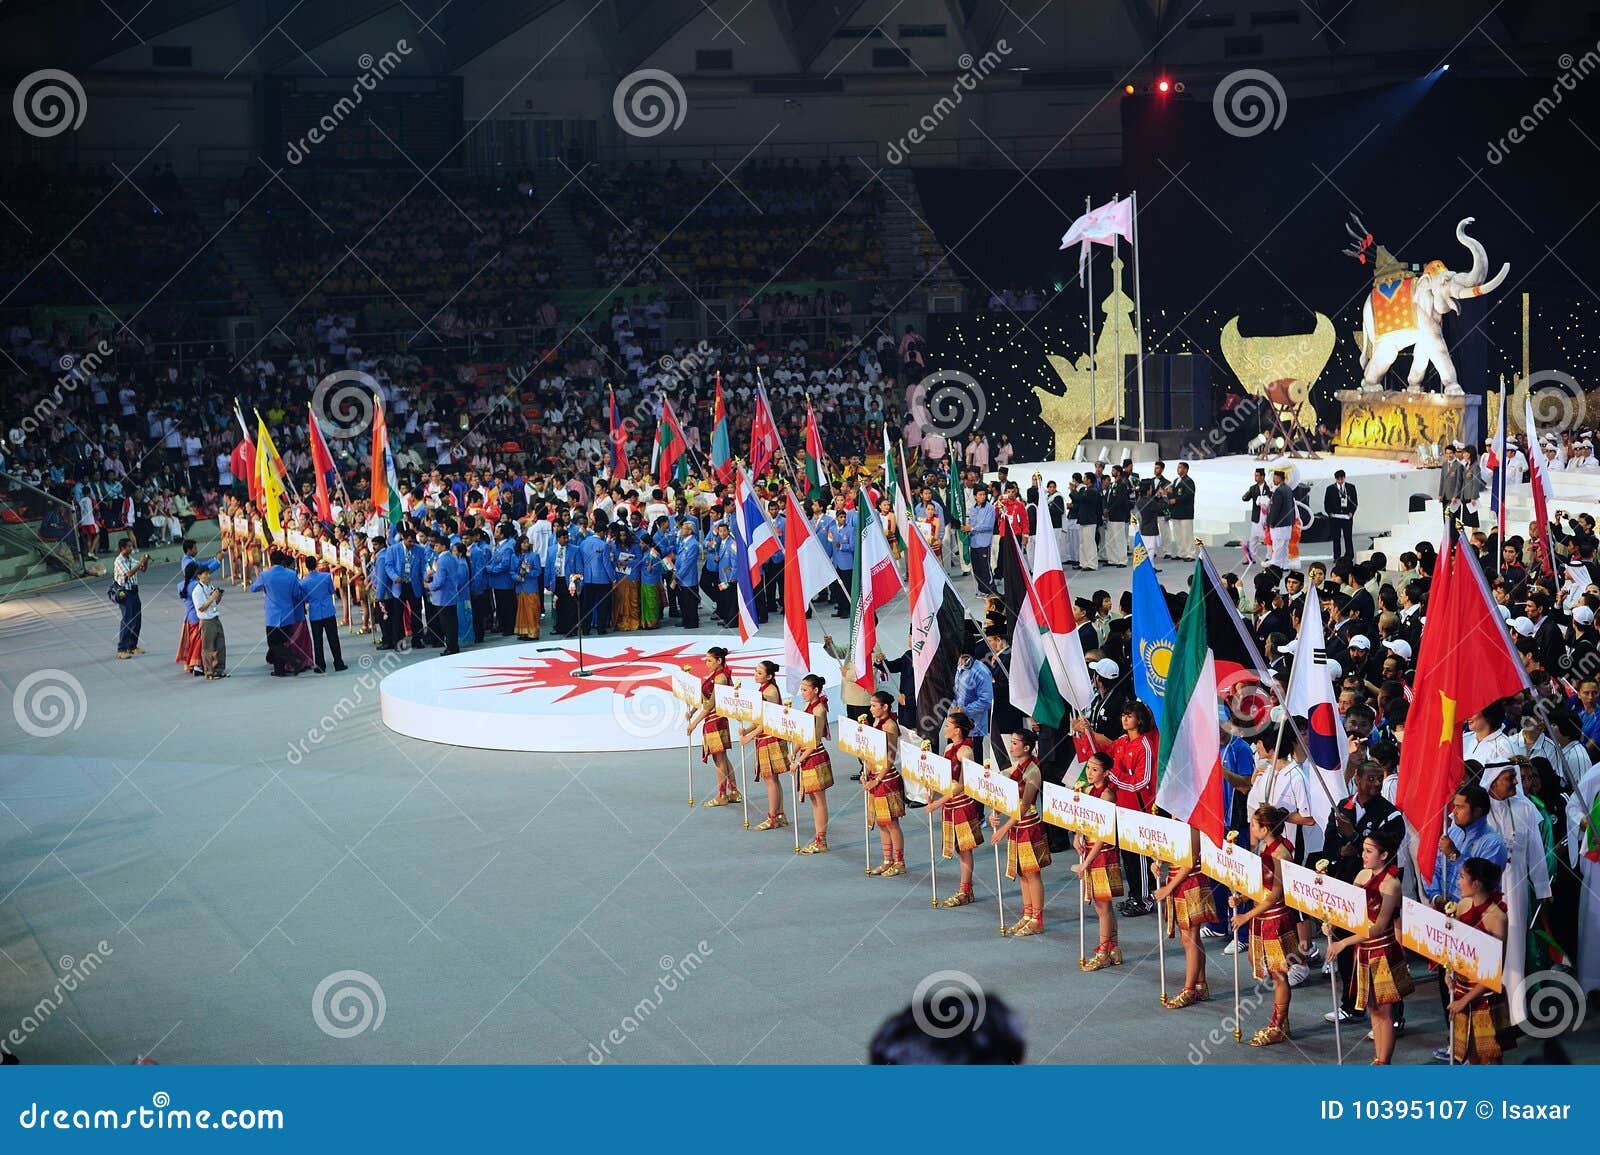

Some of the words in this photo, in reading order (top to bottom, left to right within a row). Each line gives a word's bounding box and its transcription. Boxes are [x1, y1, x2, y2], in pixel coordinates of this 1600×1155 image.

[781, 717, 797, 729] IRAN
[917, 759, 935, 775] JAPAN
[977, 776, 1005, 797] JORDAN
[1051, 797, 1106, 825] KAZAKHSTAN
[1138, 825, 1168, 845] KOREA
[1216, 851, 1245, 876] KUWAIT
[1293, 879, 1356, 915] KYRGYZSTAN
[1425, 923, 1477, 961] VIETNAM
